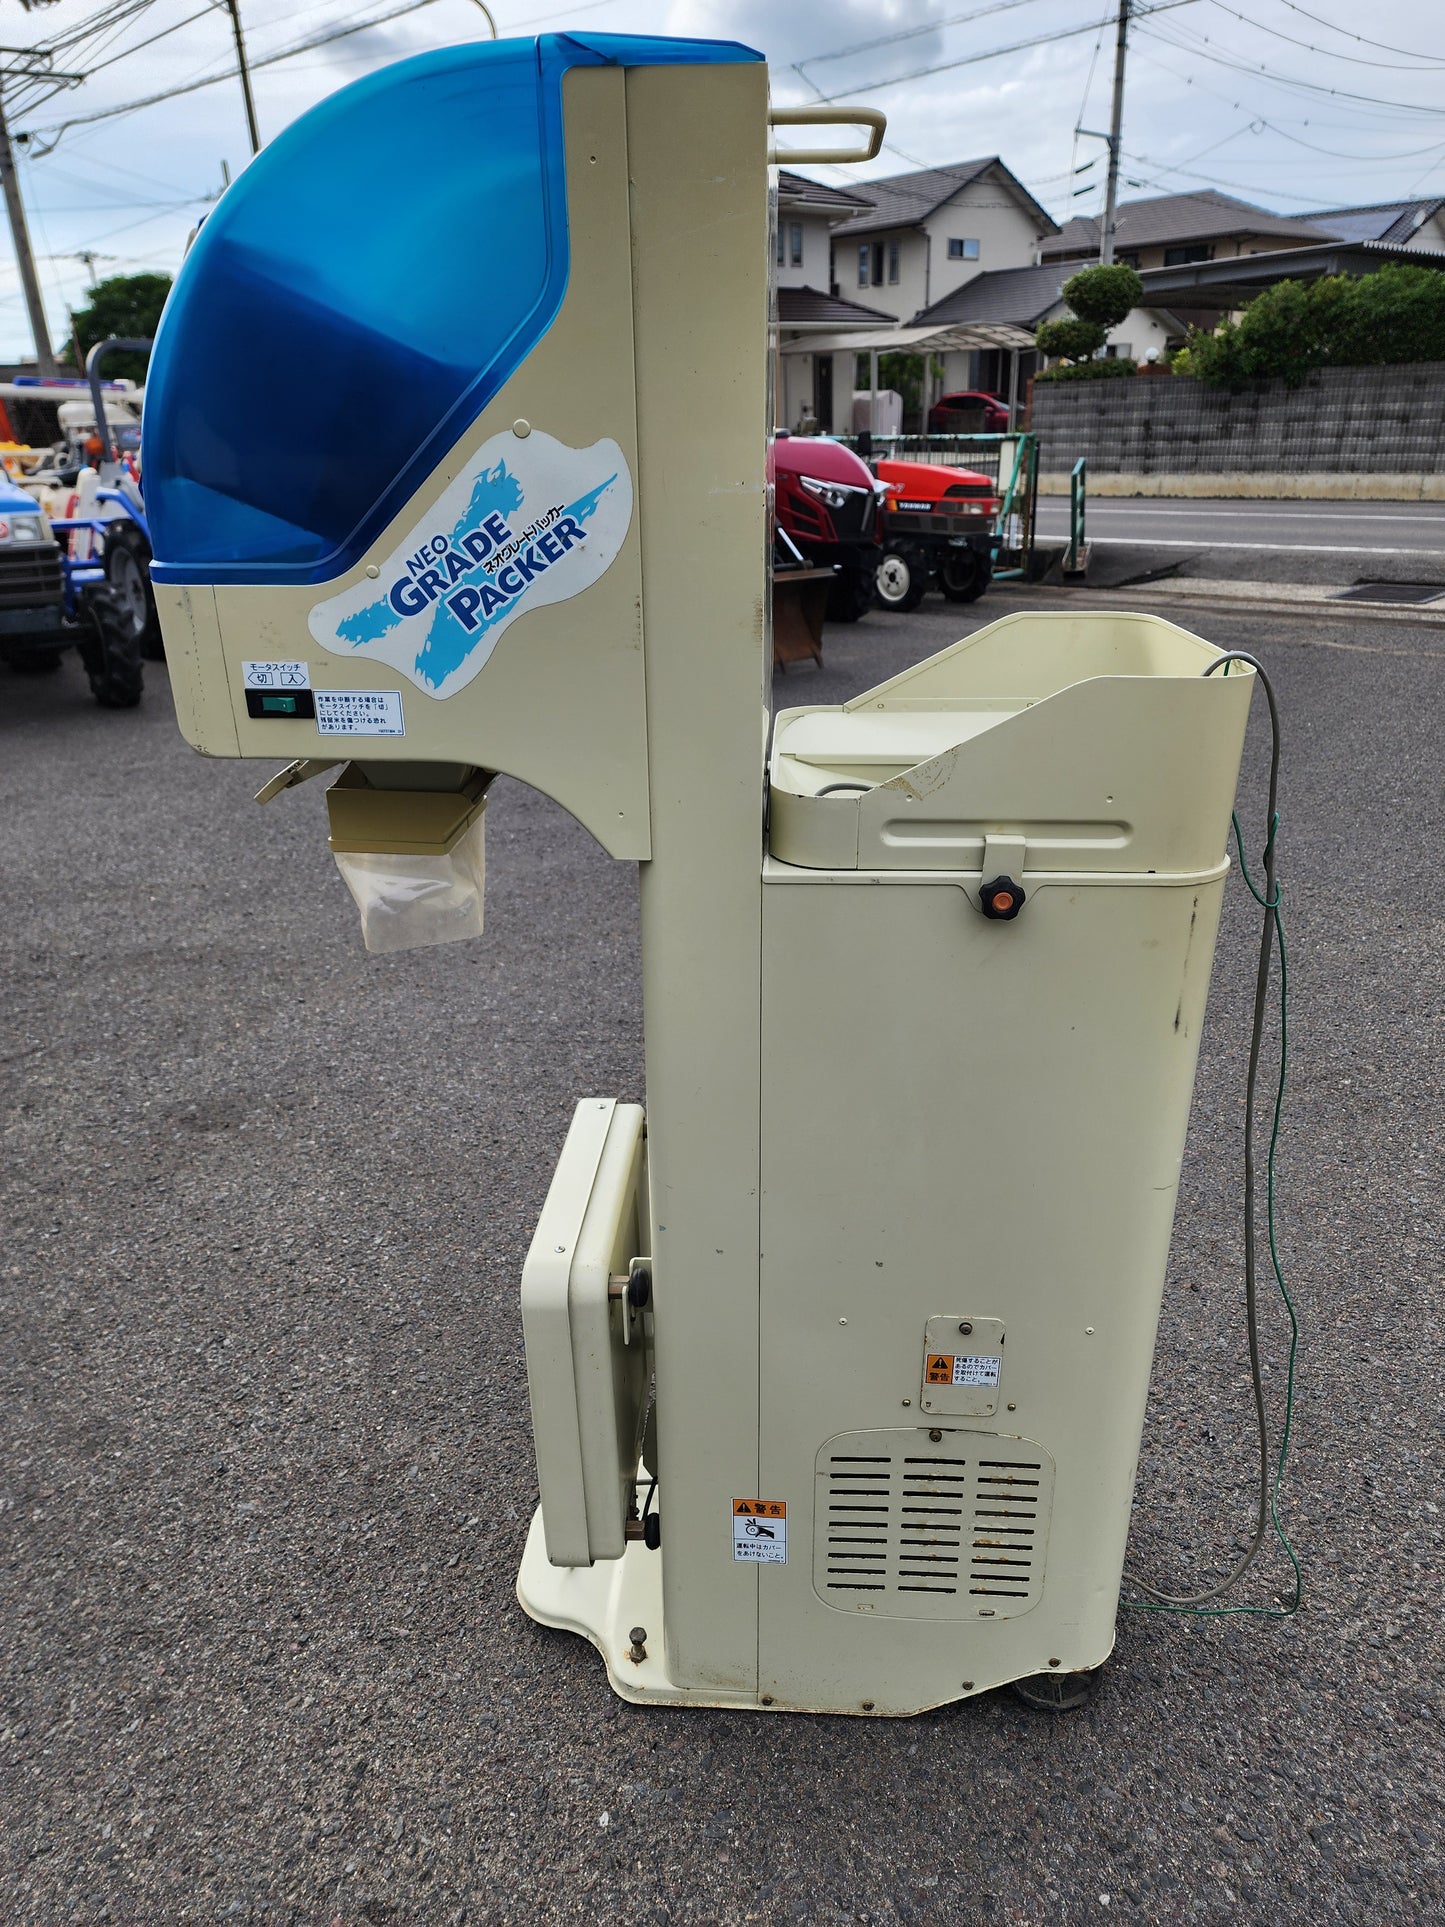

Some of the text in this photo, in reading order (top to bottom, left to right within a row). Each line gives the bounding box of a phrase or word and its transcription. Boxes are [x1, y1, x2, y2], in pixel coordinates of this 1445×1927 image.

[405, 535, 449, 577] NEO
[389, 513, 512, 617] GRADE
[447, 517, 587, 631] PACKER
[250, 663, 301, 671] モータスイッチ
[256, 674, 267, 684] 切
[289, 674, 298, 684] 入
[929, 1372, 950, 1381] 警告
[754, 1503, 781, 1514] 警告
[736, 1542, 781, 1550] 運転中はカバー
[737, 1550, 784, 1559] をあけないこと。
